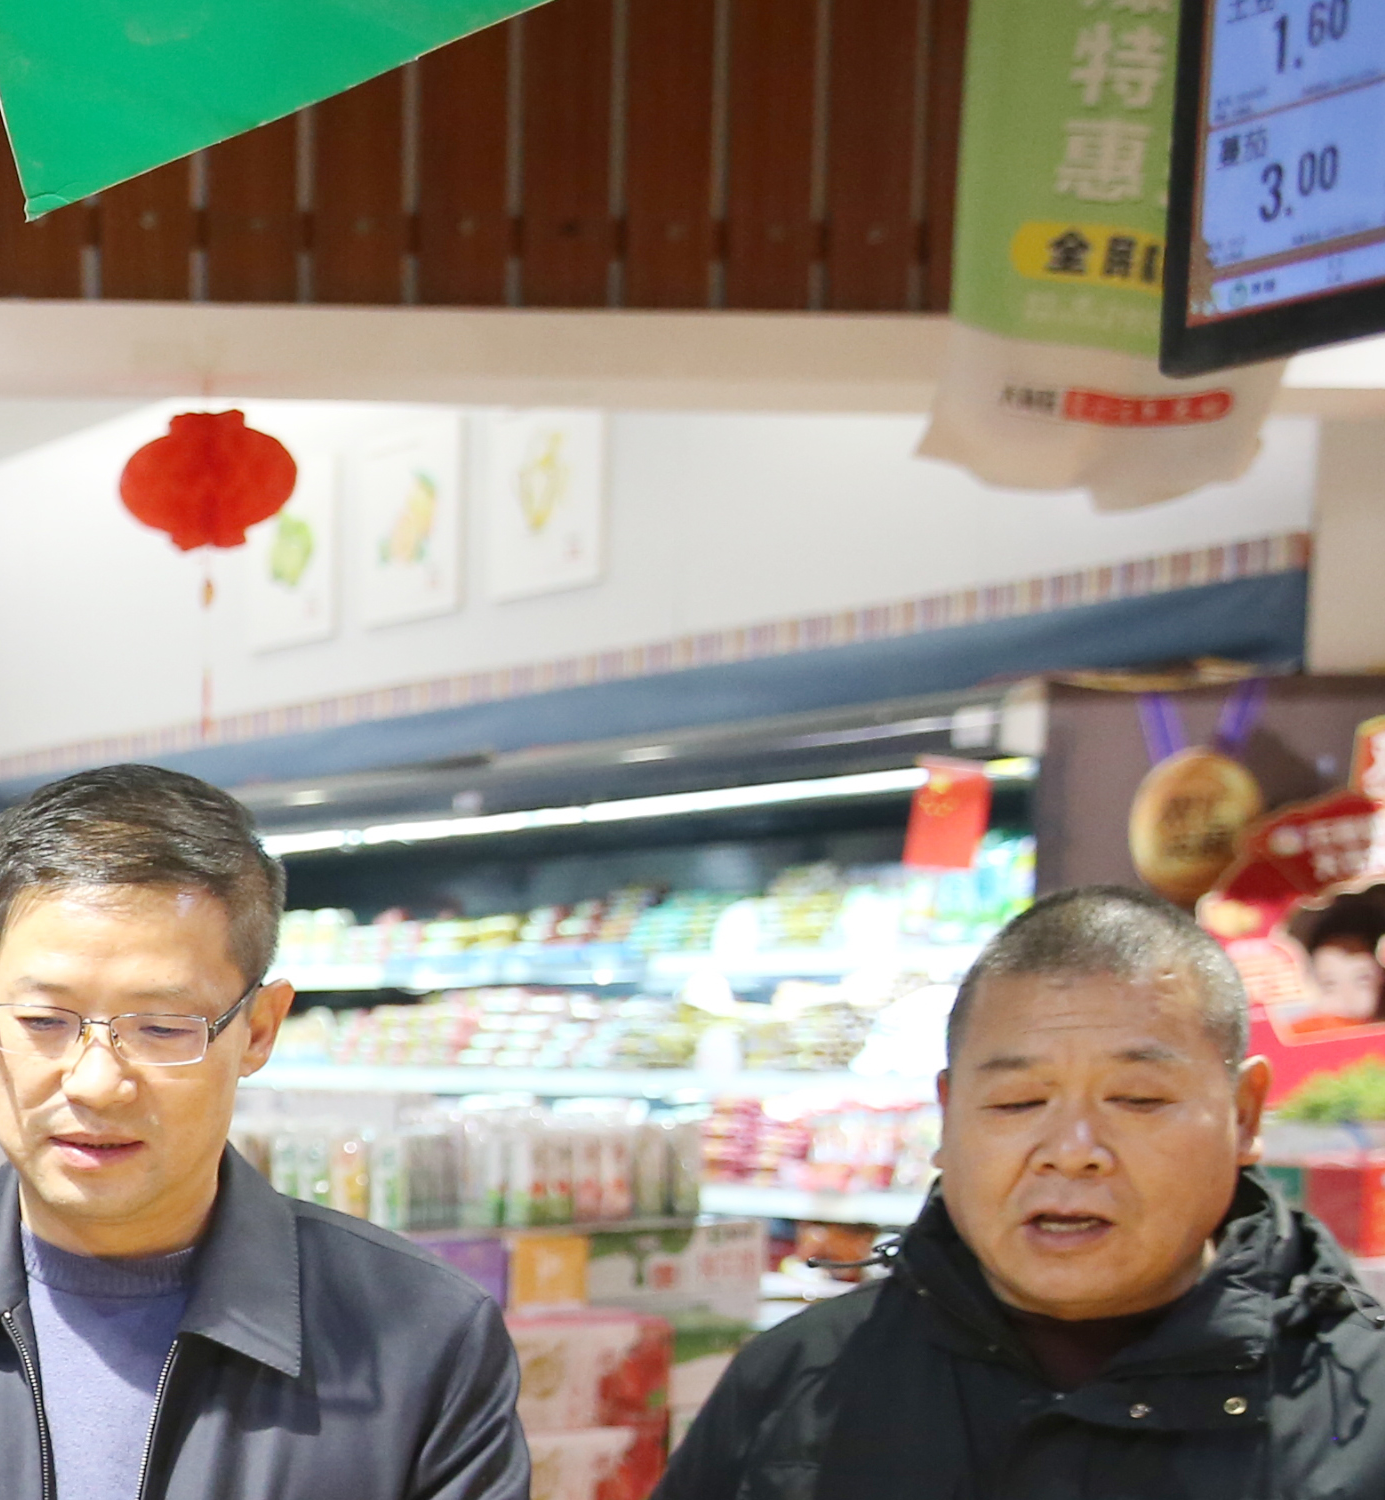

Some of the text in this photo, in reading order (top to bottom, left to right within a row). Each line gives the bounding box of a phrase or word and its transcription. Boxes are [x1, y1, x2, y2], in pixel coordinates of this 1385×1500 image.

[1274, 0, 1350, 74] 1.60
[1054, 0, 1171, 201] 特惠
[1259, 145, 1339, 222] 3.00
